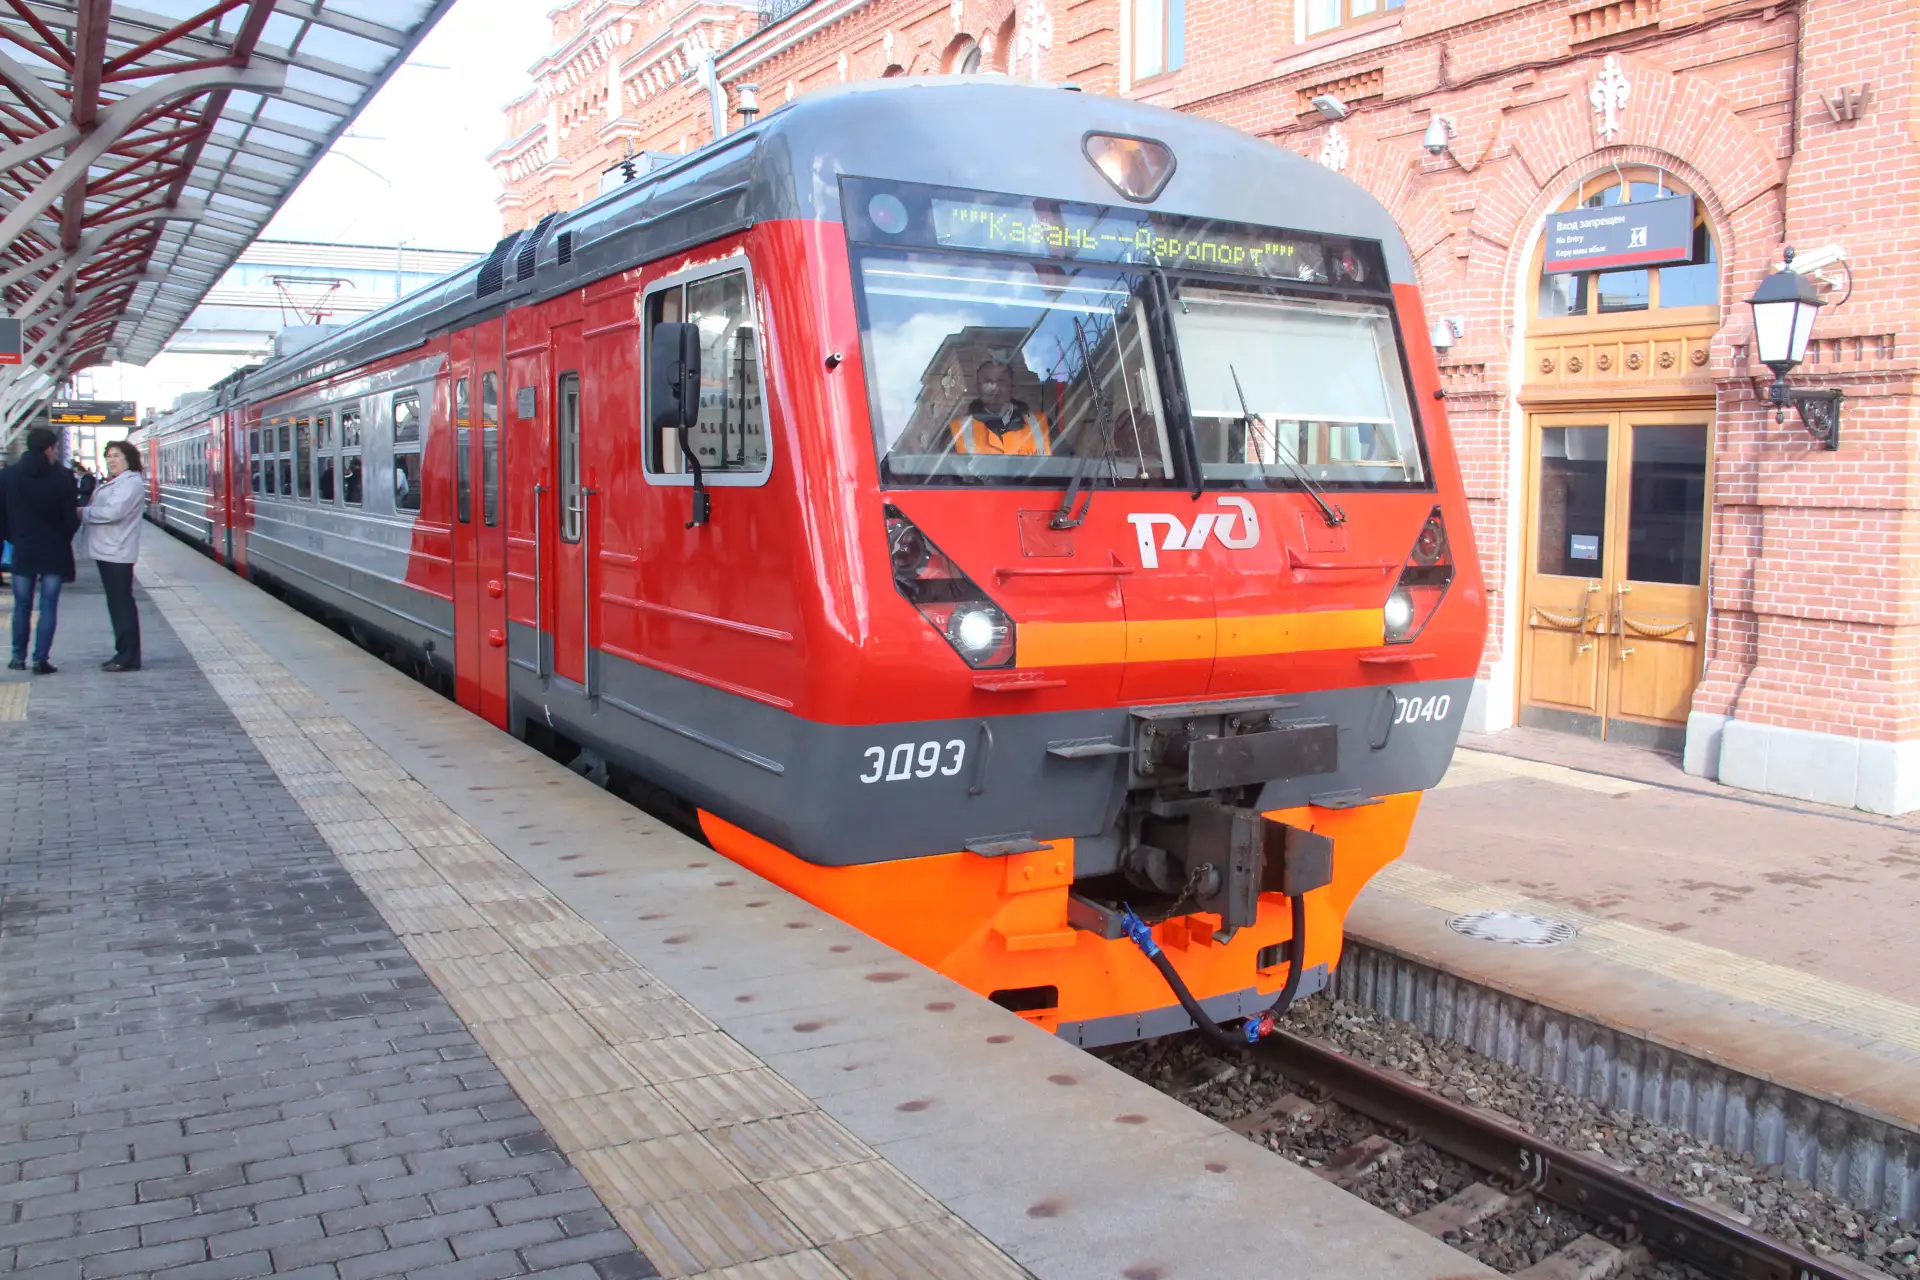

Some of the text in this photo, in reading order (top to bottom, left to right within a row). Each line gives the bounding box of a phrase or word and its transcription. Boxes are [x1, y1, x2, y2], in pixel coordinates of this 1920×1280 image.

[1556, 215, 1626, 231] Вход запрещен
[1556, 235, 1584, 244] No Entry
[1394, 694, 1451, 724] 0040
